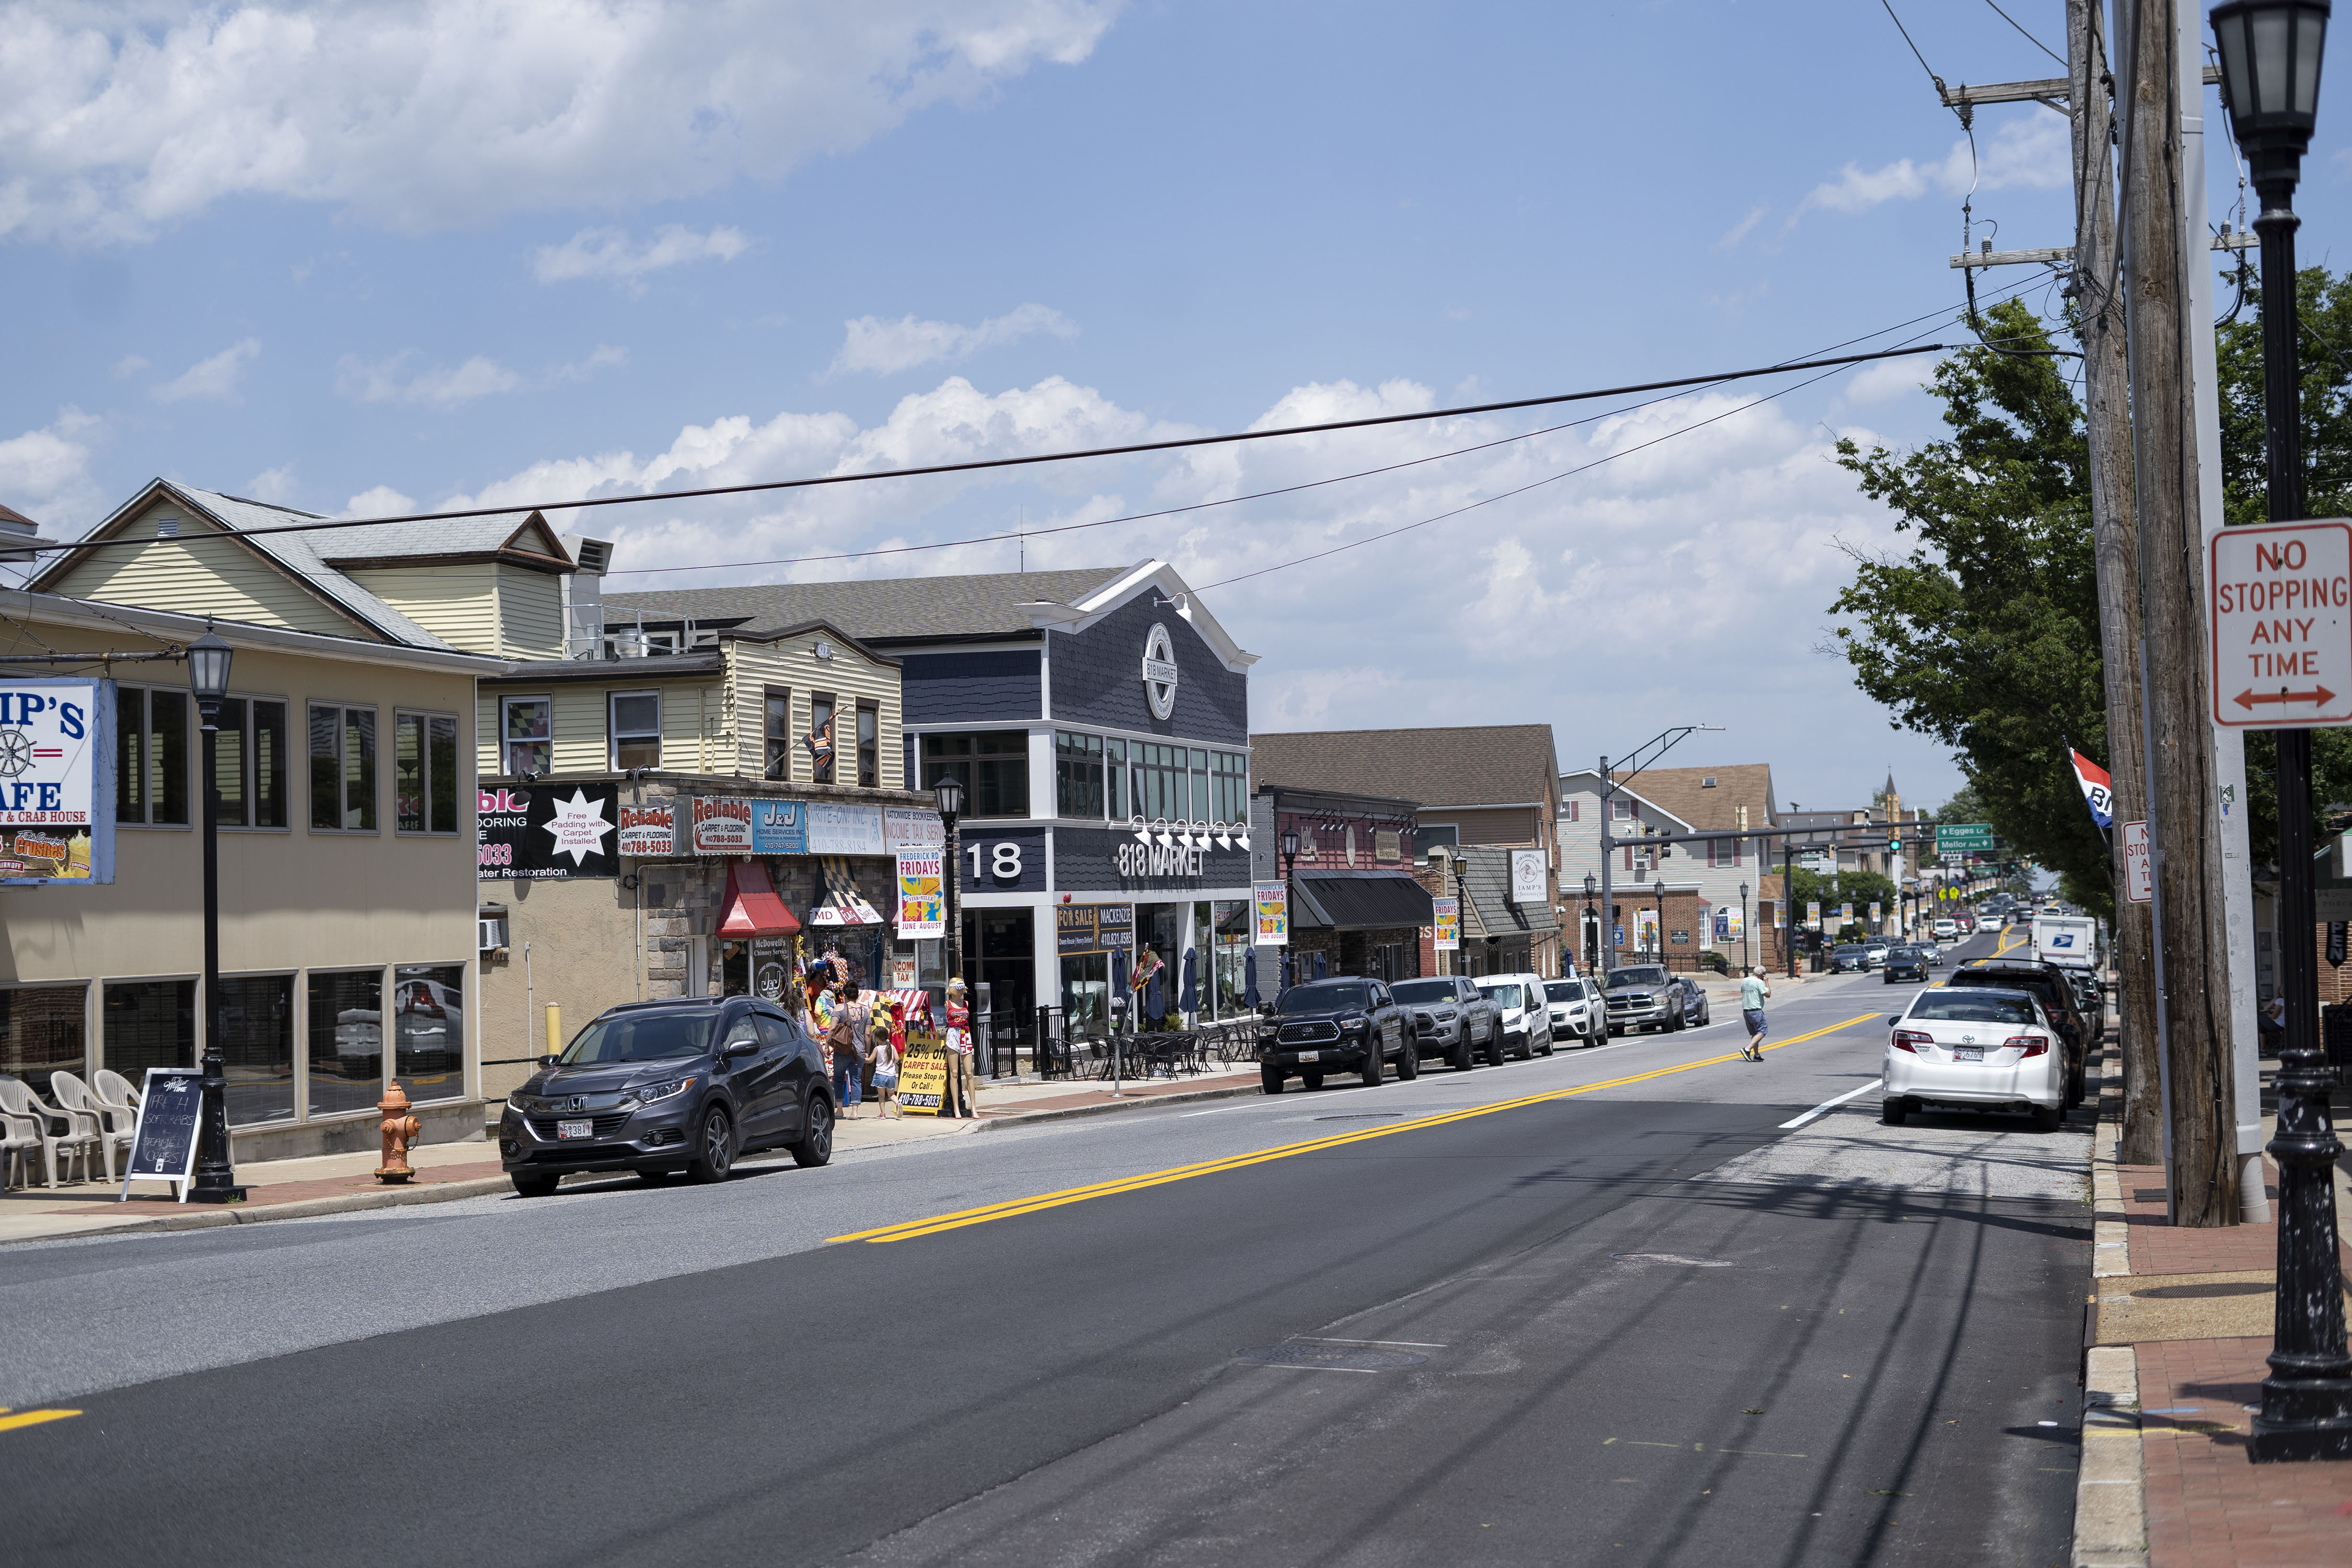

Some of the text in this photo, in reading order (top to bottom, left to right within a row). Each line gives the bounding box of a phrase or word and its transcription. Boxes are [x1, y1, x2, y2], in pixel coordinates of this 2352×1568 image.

[2256, 539, 2307, 573] NO
[2219, 576, 2347, 614] STOPPING
[2251, 617, 2315, 645] ANY
[818, 645, 828, 656] 822
[1147, 663, 1176, 680] 818 MARKET
[2248, 651, 2320, 678] TIME
[6, 811, 15, 822] &
[18, 811, 47, 822] CRAB
[50, 811, 86, 822] HOUSE
[620, 808, 673, 831] Reliable
[694, 799, 752, 826] Reliable
[764, 802, 797, 826] J&J
[809, 804, 867, 825] WRITE-ON! INC.
[886, 810, 941, 822] NATIONWIDE BOOKKEEPING
[701, 824, 720, 833] CARPET
[724, 824, 746, 833] FLOORING
[886, 822, 909, 839] INCOME
[912, 823, 924, 840] TAX
[1949, 827, 1974, 836] Egges
[18, 830, 64, 846] Fresh Squeezed
[1376, 839, 1399, 848] Veterinary
[765, 841, 799, 850] 410-747-5200
[812, 838, 867, 854] 410-788-8184
[1119, 843, 1206, 877] 818 MARKET
[1379, 848, 1398, 858] Hospital
[0, 861, 22, 870] IRNOFF
[502, 867, 567, 878] Restoration
[901, 861, 940, 875] FRIDAYS
[1258, 891, 1284, 901] FRIDAYS
[814, 911, 833, 920] MD
[1100, 908, 1132, 924] MACKENZIE
[1435, 906, 1457, 914] FRIDAYS
[1058, 909, 1093, 927] FOR SALE
[755, 938, 786, 948] McDowell's
[1101, 931, 1132, 946] 410.821.8585
[761, 970, 781, 991] J&J
[896, 972, 909, 982] TAX
[907, 1043, 947, 1060] 25% off
[903, 1060, 947, 1070] CARPET SALE
[164, 1079, 189, 1092] Miller
[898, 1093, 940, 1107] 410-788-5033
[141, 1137, 185, 1148] STEAMED
